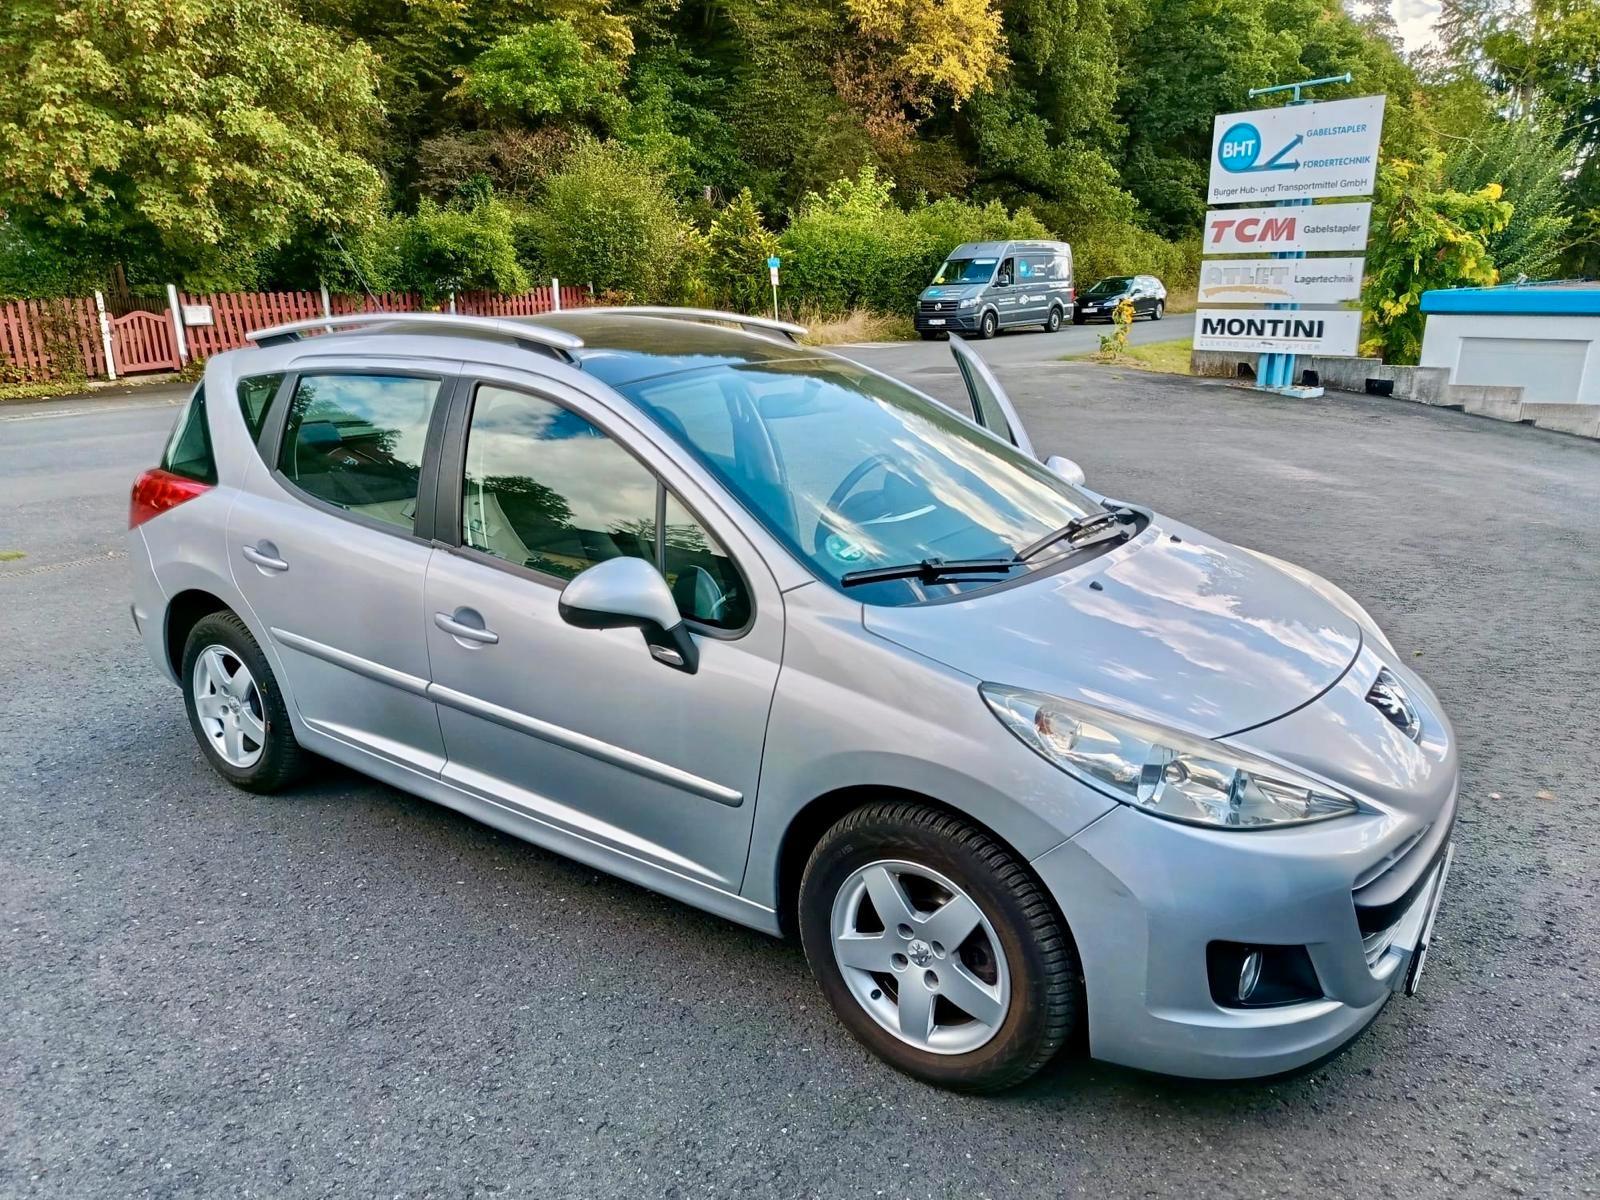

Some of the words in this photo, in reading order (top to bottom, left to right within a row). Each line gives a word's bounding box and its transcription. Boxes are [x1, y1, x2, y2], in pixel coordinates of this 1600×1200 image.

[1306, 124, 1367, 137] GABELSTAPLER
[1222, 140, 1256, 159] BHT
[1213, 187, 1238, 197] Burger
[1239, 186, 1258, 194] Hub-
[1260, 184, 1275, 193] und
[1277, 180, 1338, 192] Transportmittel
[1340, 178, 1368, 188] GmbH
[1210, 218, 1296, 243] TCM
[1303, 224, 1361, 235] Gabelstapler
[1294, 274, 1354, 285] Lagertechnik
[1202, 318, 1324, 338] MONTINI
